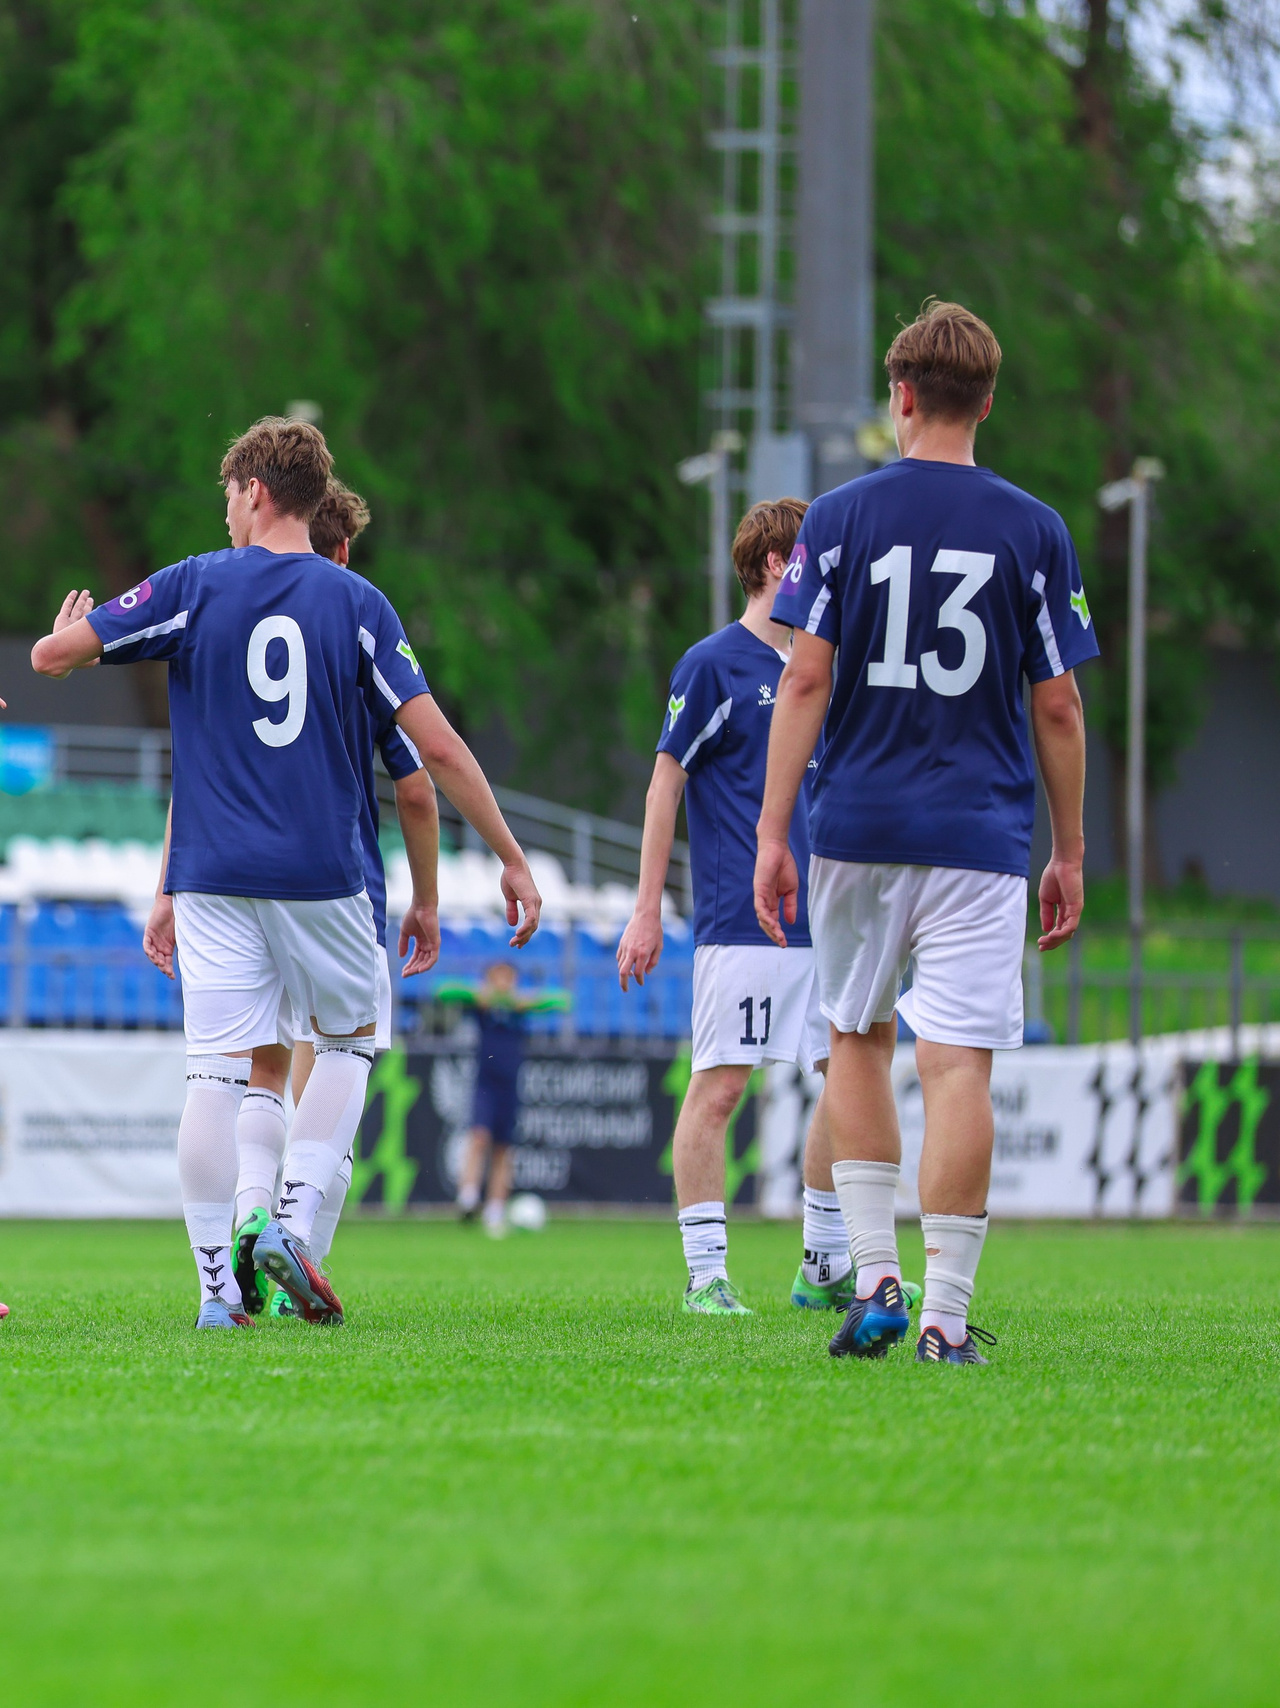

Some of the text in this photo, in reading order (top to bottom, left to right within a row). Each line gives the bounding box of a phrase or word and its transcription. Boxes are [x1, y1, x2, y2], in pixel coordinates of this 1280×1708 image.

[867, 545, 996, 697] 13
[246, 614, 308, 748] 9
[738, 996, 772, 1046] 11
[186, 1073, 232, 1085] KELME
